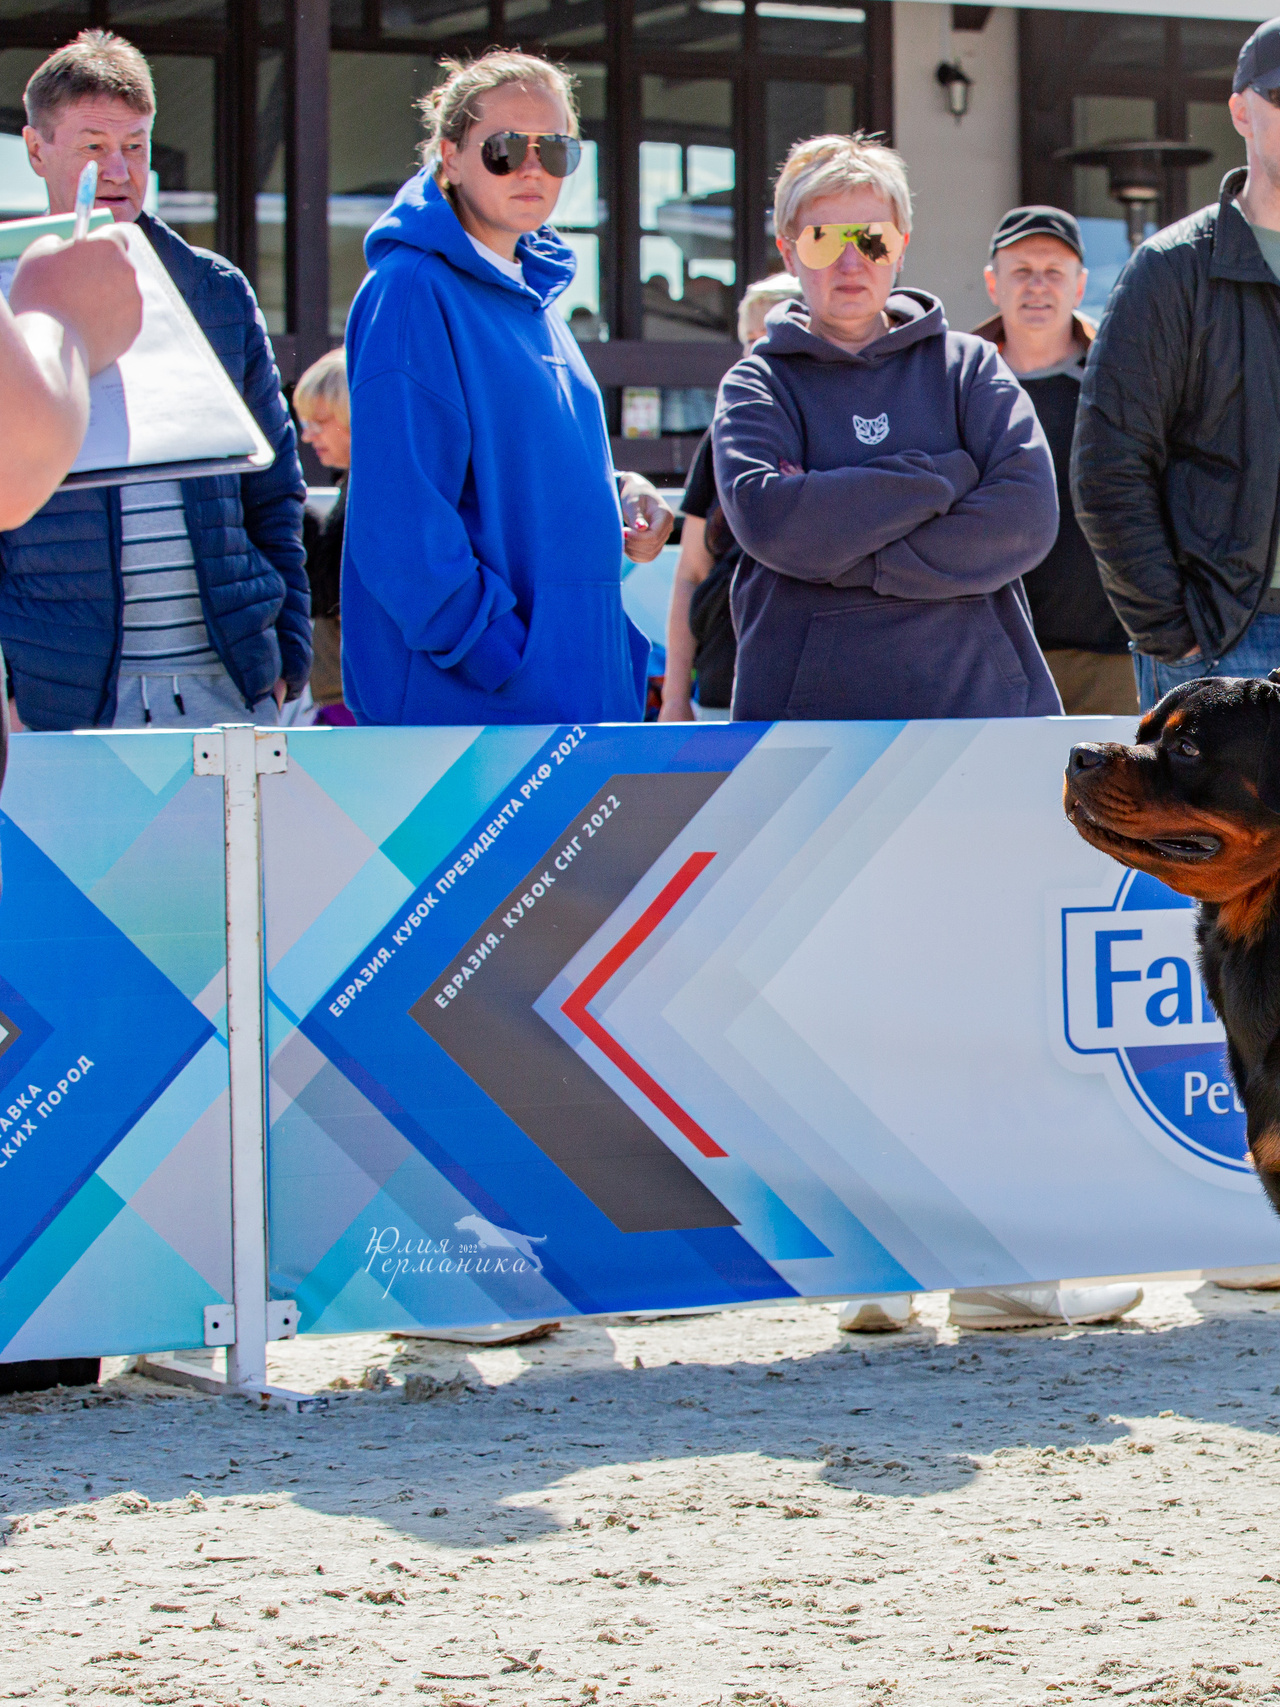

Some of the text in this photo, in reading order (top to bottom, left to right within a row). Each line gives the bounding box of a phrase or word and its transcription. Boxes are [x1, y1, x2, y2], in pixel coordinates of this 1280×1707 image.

[328, 725, 588, 1018] ЕВРАЗИЯ. КУБОК ПРЕЗИДЕНТА РКФ 2022
[433, 794, 622, 1010] ЕВРАЗИЯ. КУБОК СНГ 2022
[0, 1084, 42, 1138] АВКА
[36, 1055, 95, 1119] ПОРОД
